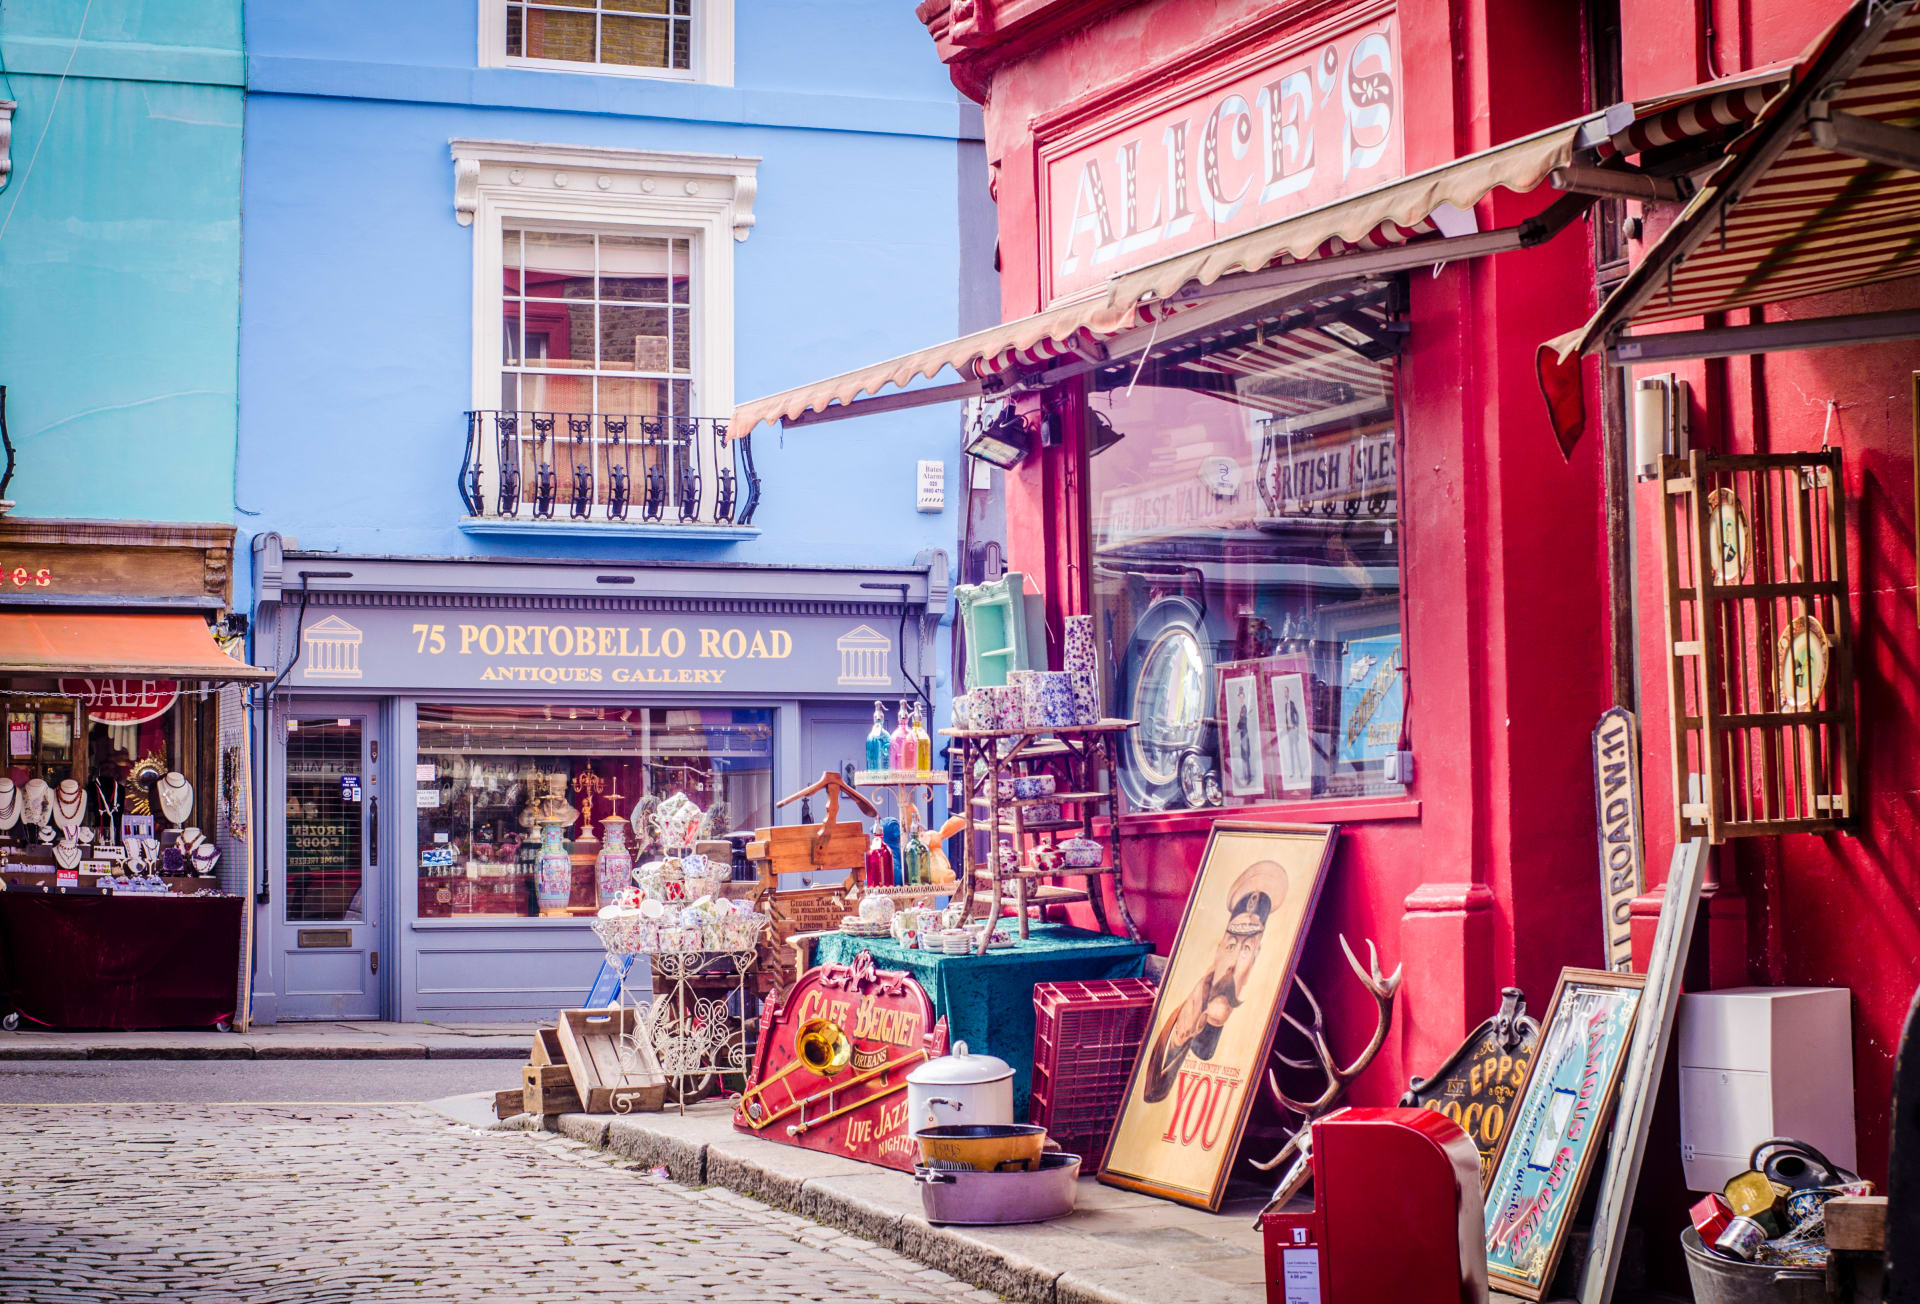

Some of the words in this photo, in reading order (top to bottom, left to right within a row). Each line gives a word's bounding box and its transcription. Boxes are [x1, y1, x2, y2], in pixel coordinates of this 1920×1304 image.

[1059, 20, 1395, 277] ALICE’S
[1272, 452, 1341, 501] BRITISH
[0, 561, 51, 587] es
[412, 624, 446, 654] 75
[459, 624, 686, 657] PORTOBELLO
[699, 629, 793, 659] ROAD
[480, 666, 602, 683] ANTIQUES
[612, 668, 726, 684] GALLERY
[1605, 798, 1635, 896] ROAD
[798, 990, 850, 1029] CAFE
[853, 995, 921, 1048] BEIGNET
[854, 1049, 888, 1069] ORLEANS
[1469, 1055, 1528, 1096] EPPS
[1567, 1005, 1609, 1142] FAMOUS
[844, 1117, 872, 1152] LIVE
[1509, 1146, 1574, 1263] GROUSE
[1297, 1231, 1303, 1242] 1
